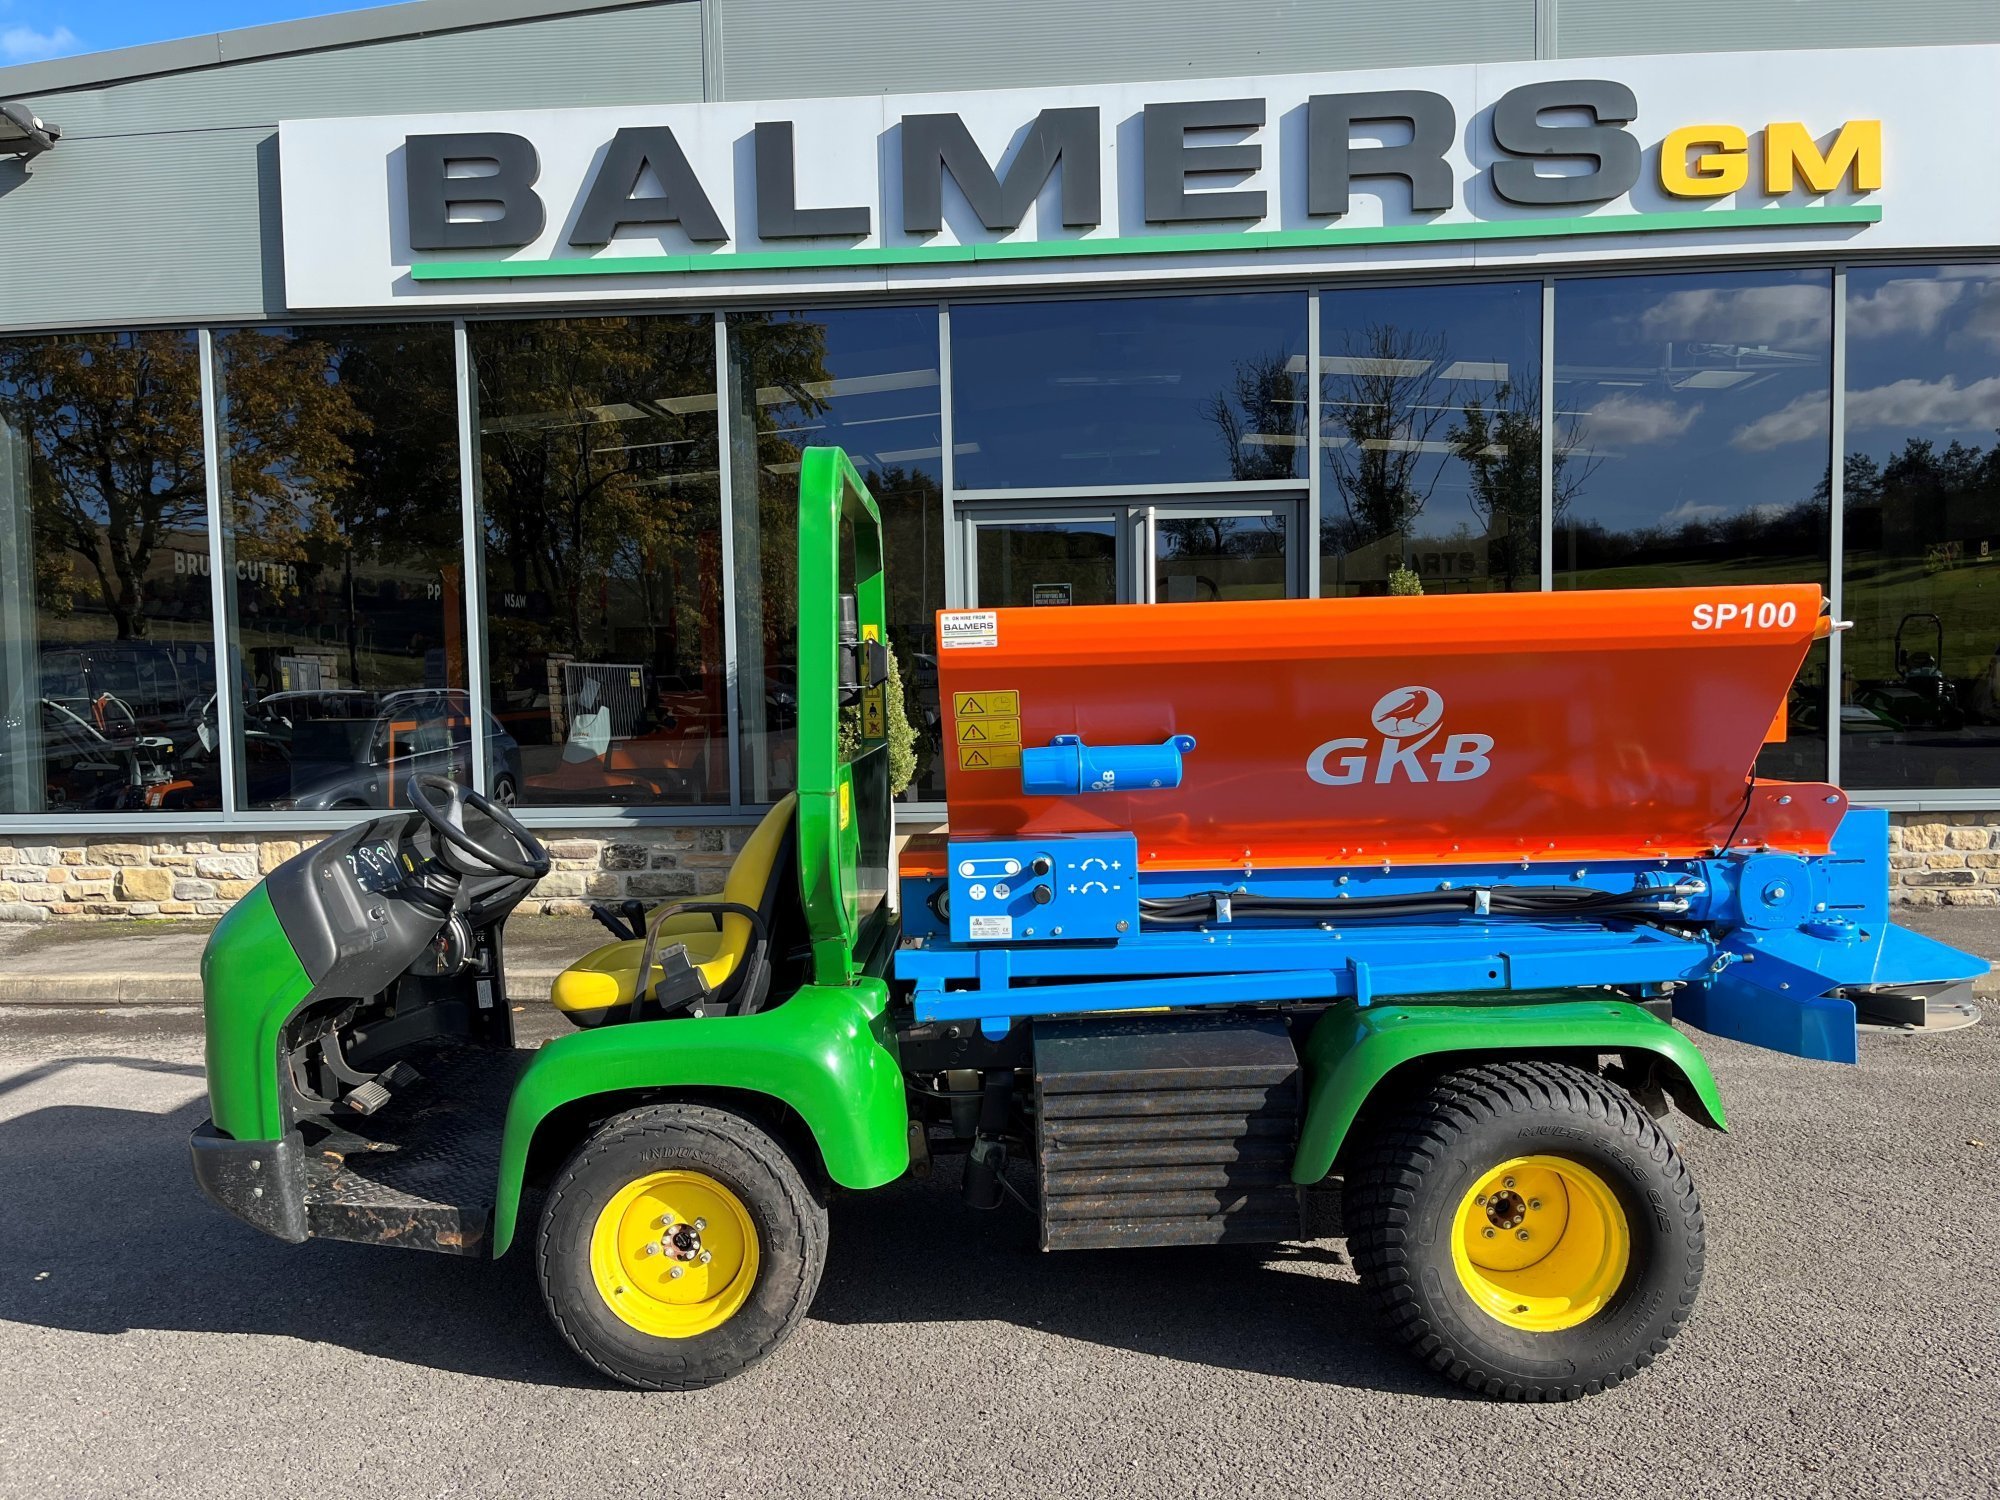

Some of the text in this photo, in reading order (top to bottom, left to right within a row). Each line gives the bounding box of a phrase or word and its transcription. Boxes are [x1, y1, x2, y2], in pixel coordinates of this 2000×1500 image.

[405, 79, 1882, 251] BALMERS GM
[174, 551, 298, 587] BRU CUTTER
[943, 622, 994, 631] BALMERS
[1691, 601, 1797, 630] SP100
[1306, 720, 1495, 786] GKB
[1518, 1125, 1592, 1141] MULTI
[641, 1147, 758, 1192] INDUSTRIAL
